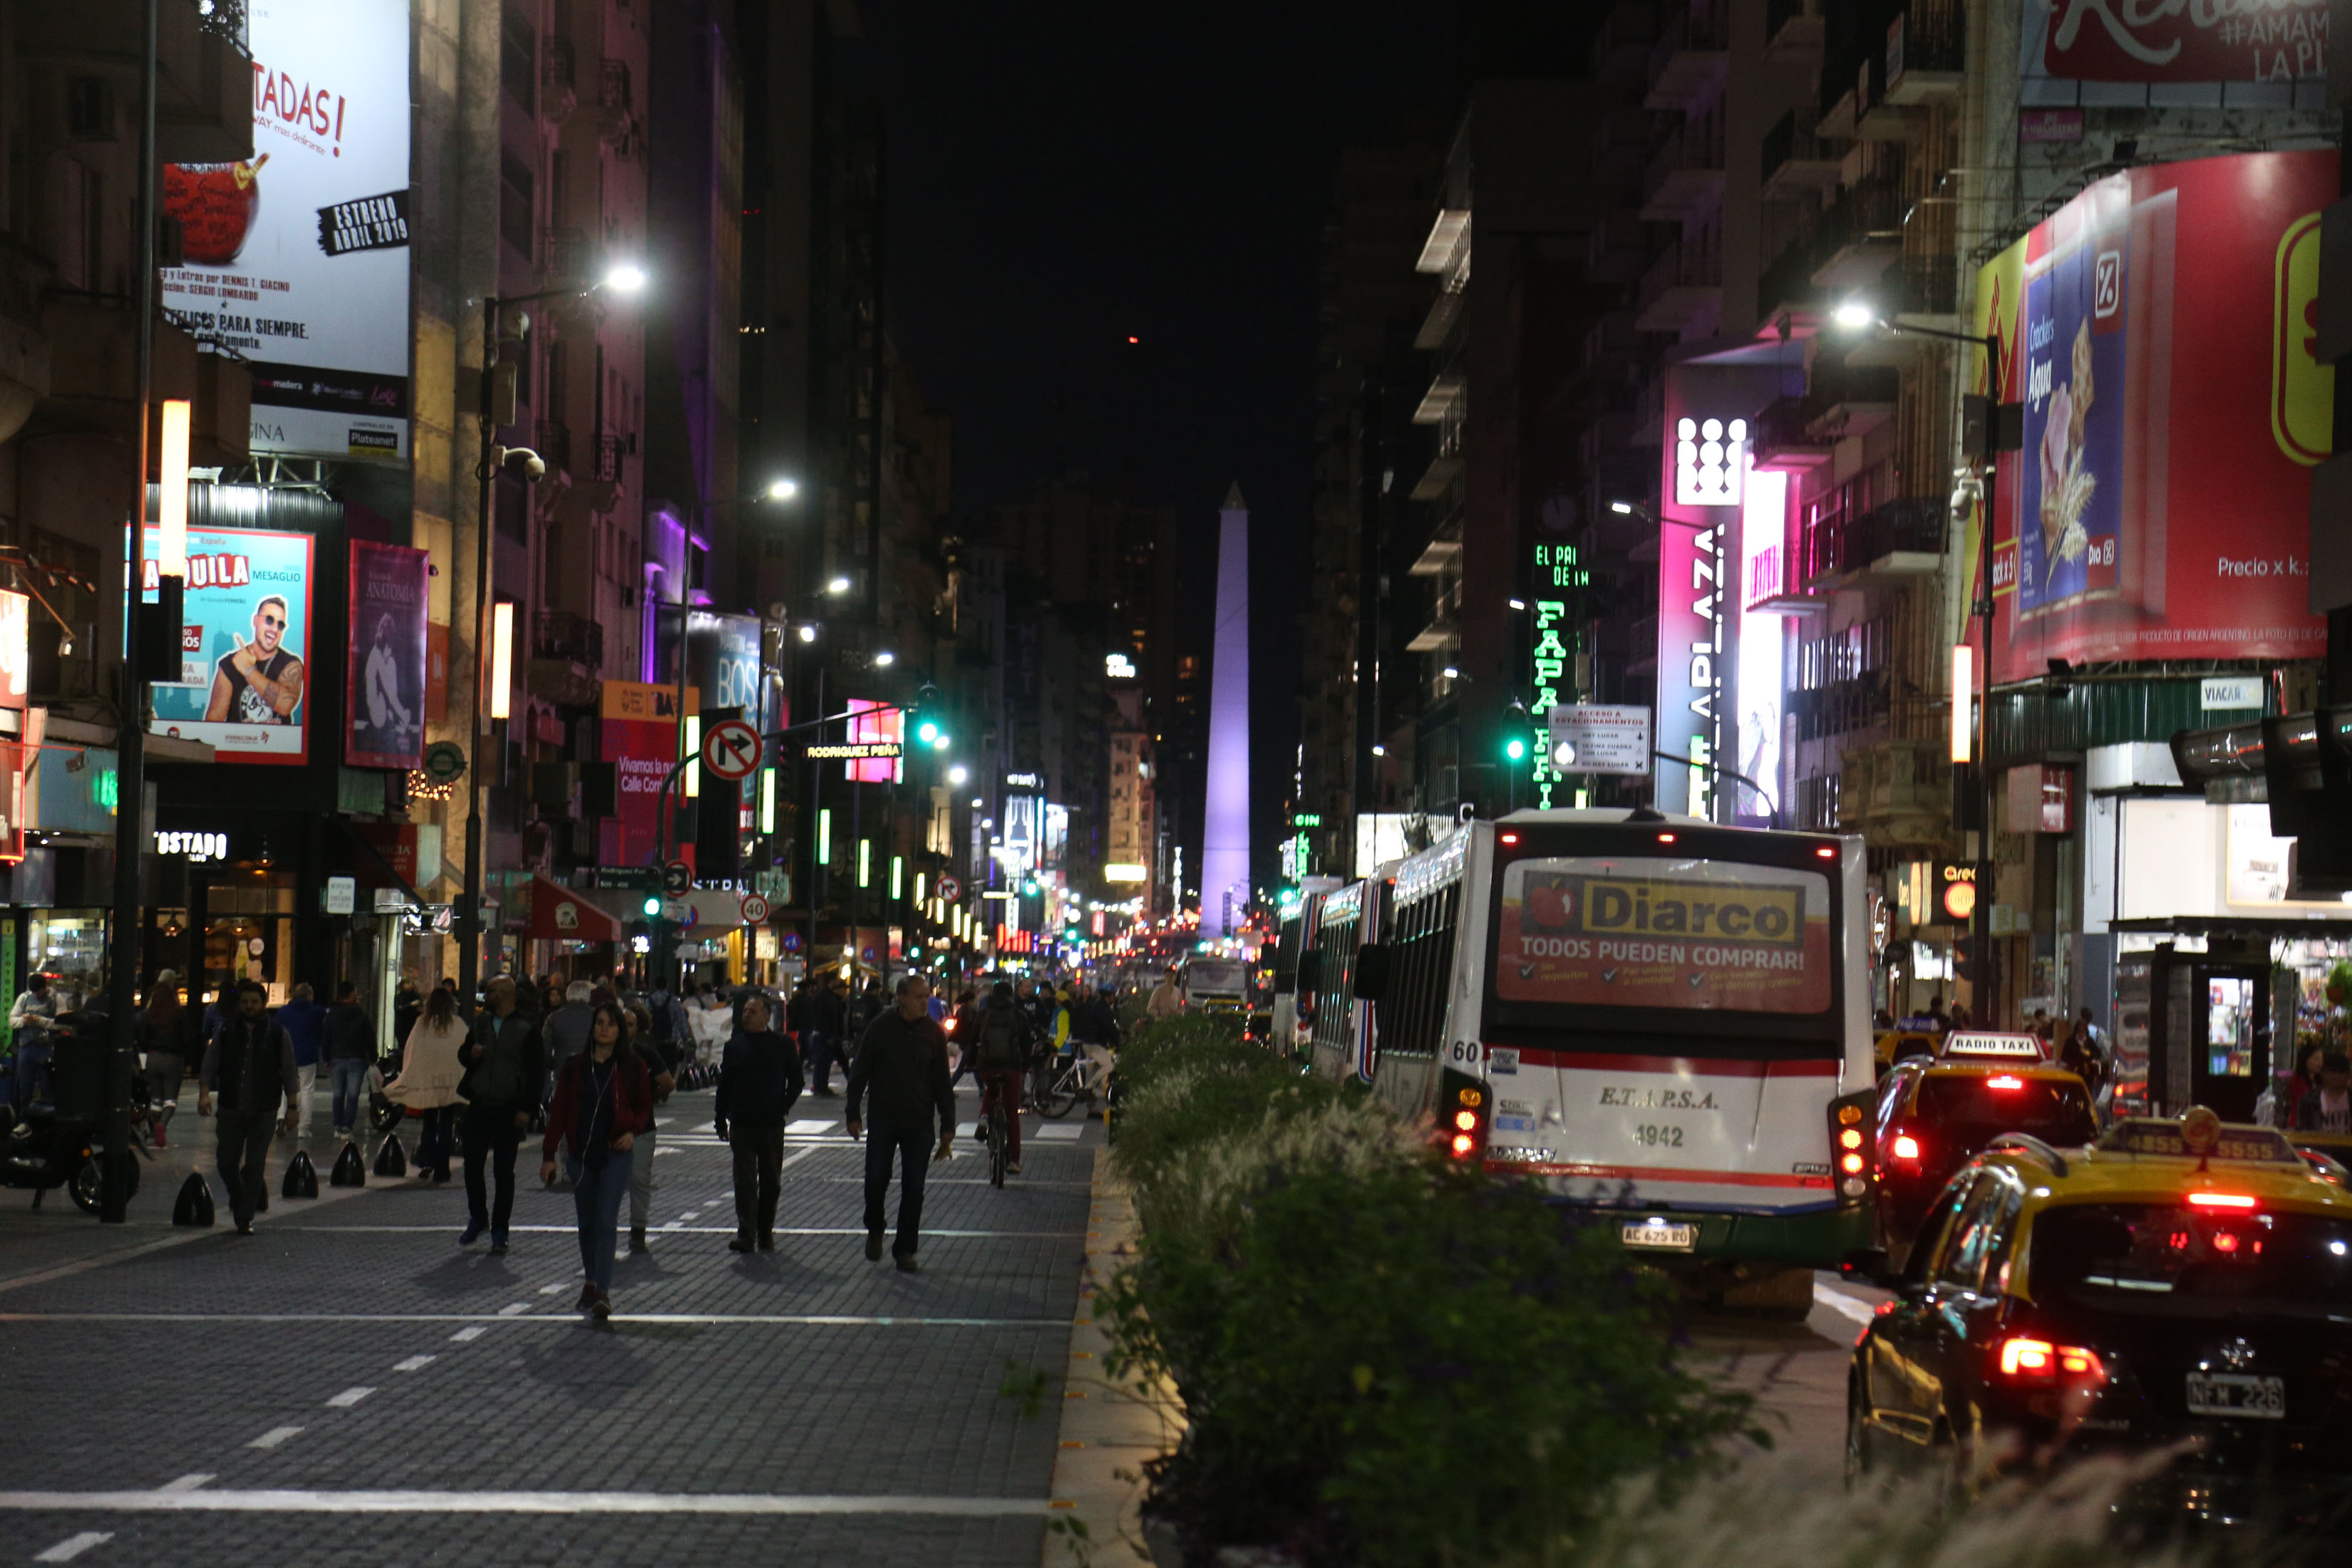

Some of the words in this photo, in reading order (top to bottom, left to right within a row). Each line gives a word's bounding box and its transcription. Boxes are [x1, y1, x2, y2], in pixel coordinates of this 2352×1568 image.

[333, 196, 397, 229] ESTRENO
[334, 225, 373, 251] ABRIL
[375, 217, 408, 243] 2019
[207, 274, 220, 284] por
[222, 275, 249, 287] DENNIS
[190, 284, 216, 296] SERGIO
[218, 289, 259, 301] LOMBARDO
[220, 314, 252, 332] PARA
[256, 319, 309, 339] SIEMPRE.
[2030, 314, 2054, 353] Crackers
[2028, 356, 2052, 413] Agua
[351, 432, 394, 446] Plateanet
[201, 536, 227, 547] España
[2218, 556, 2268, 577] Precio
[252, 570, 301, 582] MESAGLIO
[808, 746, 869, 758] RODRIGUEZ
[871, 743, 899, 757] PEÑA
[619, 756, 654, 774] Vivamos
[655, 759, 661, 774] la
[621, 775, 641, 793] Calle
[153, 831, 227, 860] OSTADO
[746, 903, 763, 915] 40
[1591, 886, 1790, 937] Diarco
[1521, 936, 1591, 959] TODOS
[1598, 941, 1685, 964] PUEDEN
[1693, 946, 1805, 971] COMPRAR!
[1541, 971, 1589, 981] requisitos
[1453, 1041, 1478, 1063] 60
[1956, 1038, 1996, 1050] RADIO
[2002, 1040, 2031, 1051] TAXI
